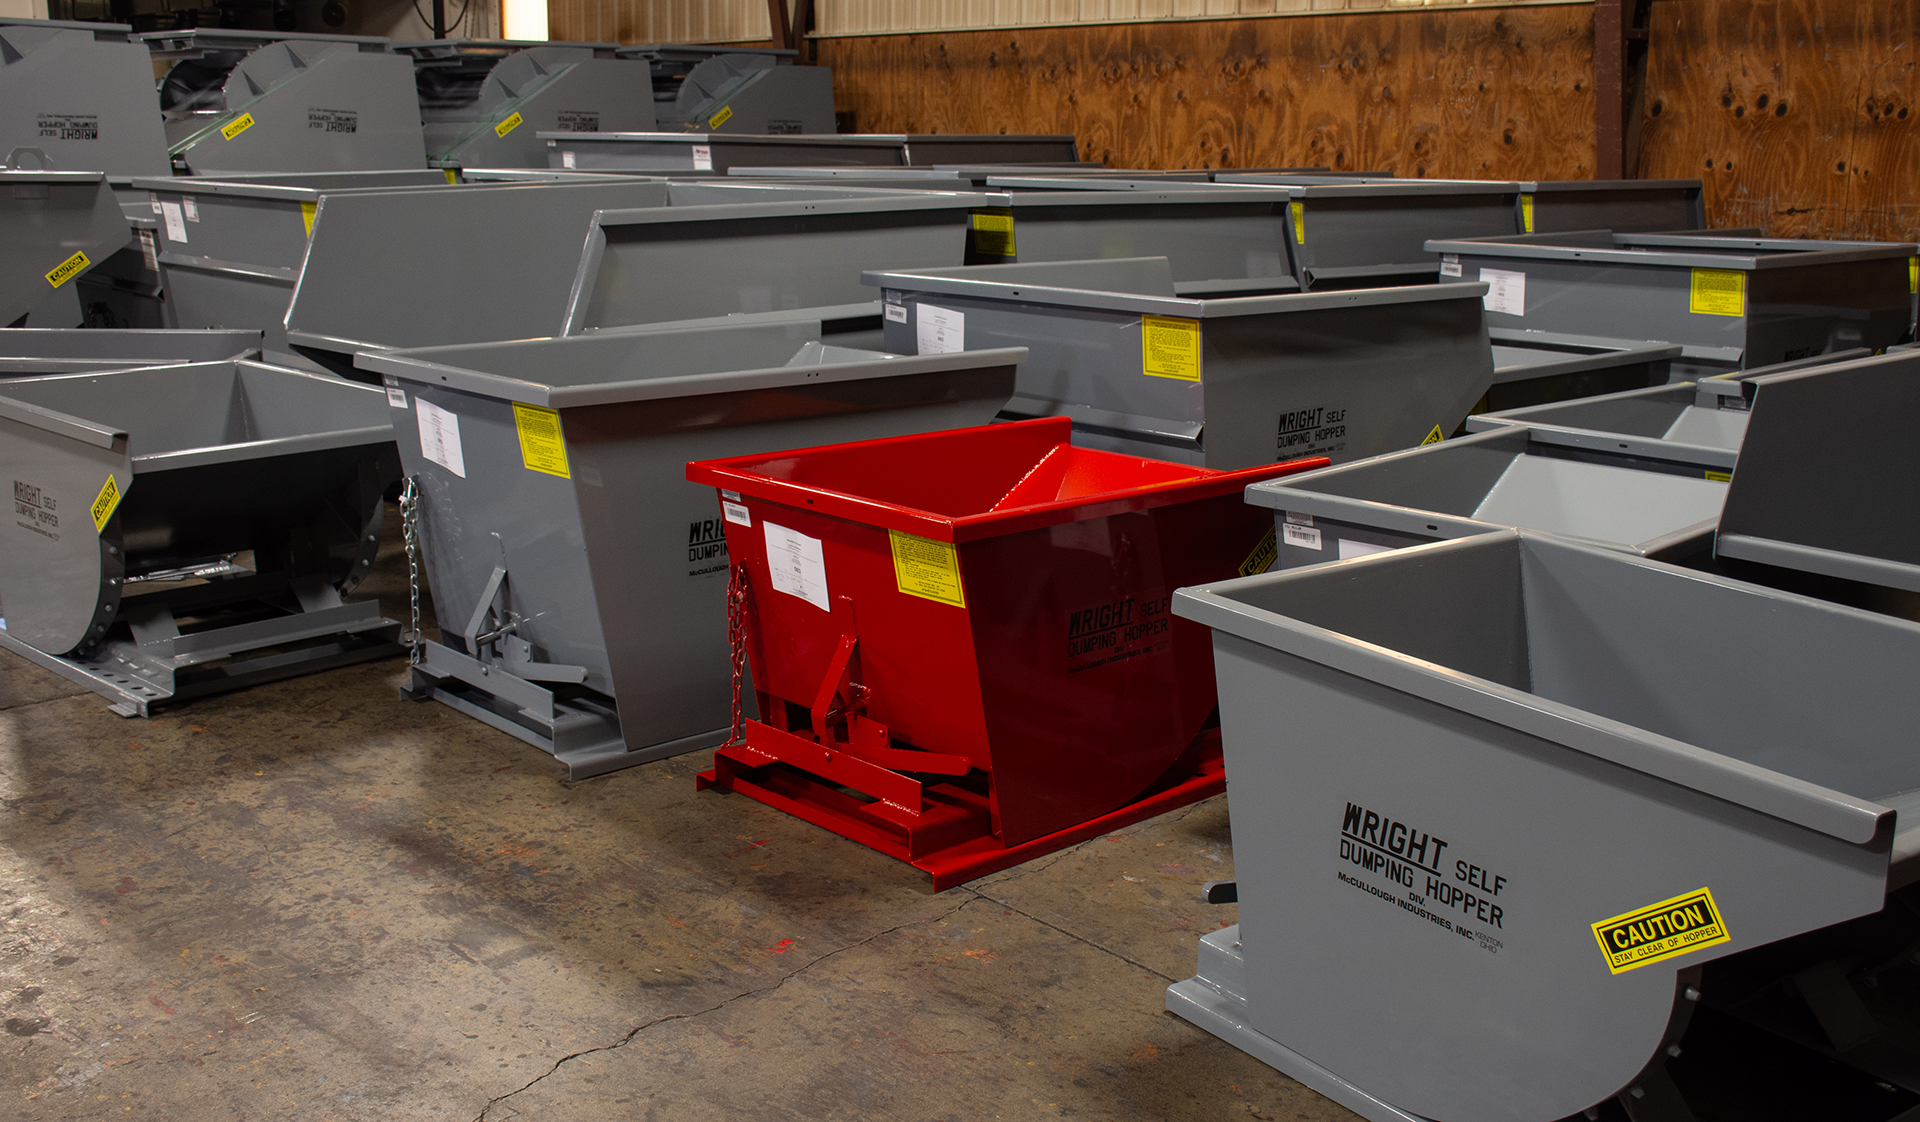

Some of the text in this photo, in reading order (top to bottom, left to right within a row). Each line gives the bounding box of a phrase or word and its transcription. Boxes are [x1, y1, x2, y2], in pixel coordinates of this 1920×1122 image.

[38, 121, 98, 129] DUMPING HOPPER
[60, 129, 98, 140] WRIGHT
[325, 122, 357, 133] WRIGHT
[53, 256, 83, 281] CAUTION
[1279, 407, 1346, 432] WRIGHT SELF
[1277, 425, 1346, 449] DUMPING HOPPER
[14, 480, 57, 511] WRIGHT SELF
[95, 483, 115, 519] CAUTION
[15, 502, 60, 528] DUMPING HOPPER
[689, 564, 729, 577] McCULLOUGH
[1069, 598, 1168, 636] WRIGHT SELF
[1068, 618, 1168, 657] DUMPING HOPPER
[1068, 659, 1106, 674] McCULLOUGH
[1342, 801, 1507, 896] WRIGHT SELF
[1340, 838, 1503, 929] DUMPING HOPPER
[1338, 871, 1475, 941] McCULLOUGH INDUSTRIES, INC.
[1408, 892, 1426, 906] DIV.
[1613, 904, 1705, 949] CAUTION
[1475, 931, 1503, 948] KENTON
[1479, 941, 1498, 953] OHIO
[1614, 926, 1718, 964] STAY CLEAR OF HOPPER
